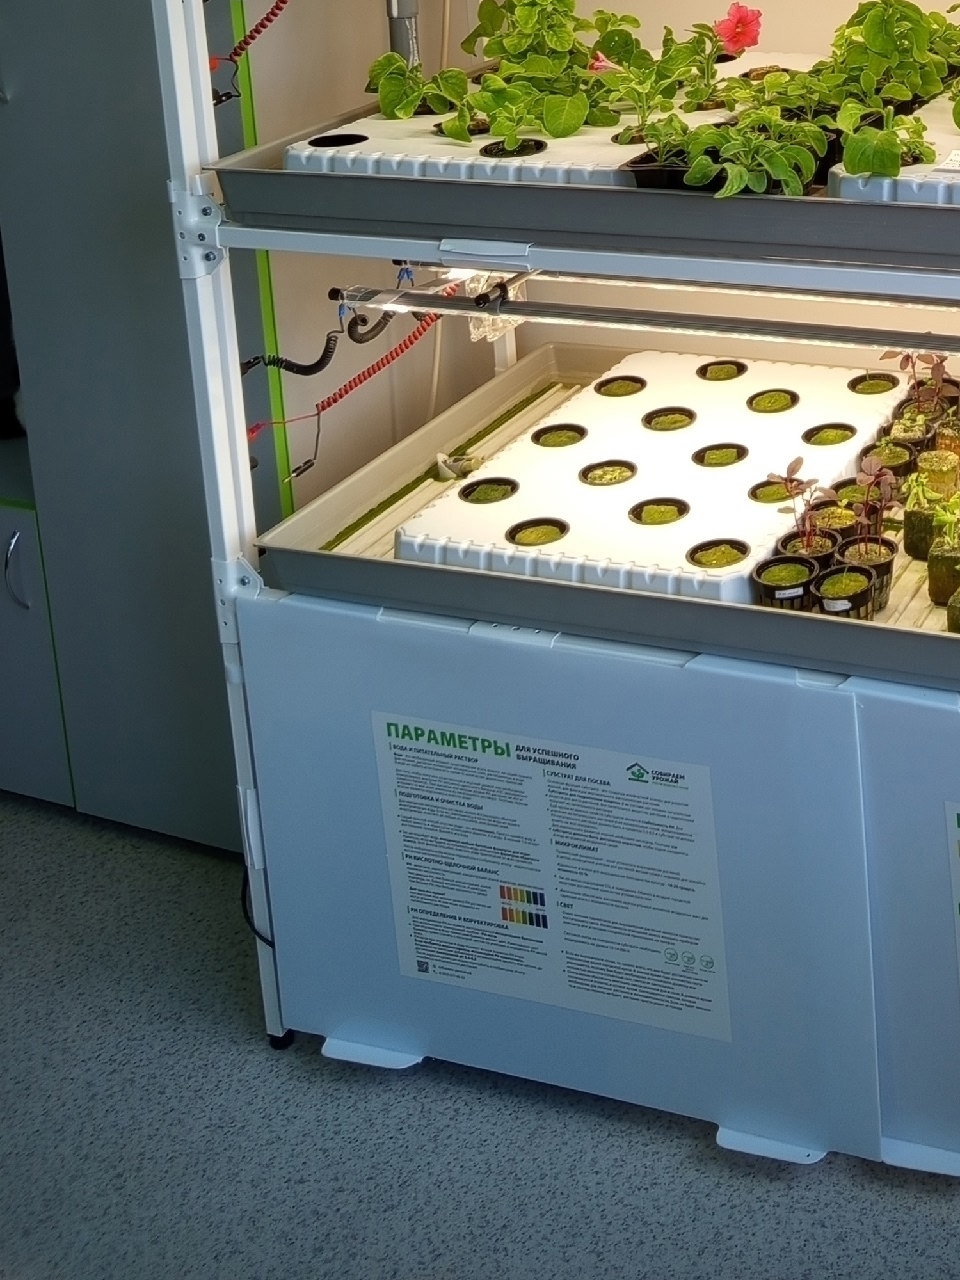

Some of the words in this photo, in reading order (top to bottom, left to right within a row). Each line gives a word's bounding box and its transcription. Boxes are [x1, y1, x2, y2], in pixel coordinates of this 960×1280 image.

[386, 722, 511, 757] ПАРАМЕТРЫ
[515, 744, 531, 754] ДЛЯ
[531, 747, 580, 761] УСПЕШНОГО
[516, 753, 577, 770] ВЫРАЩИВАНИЯ
